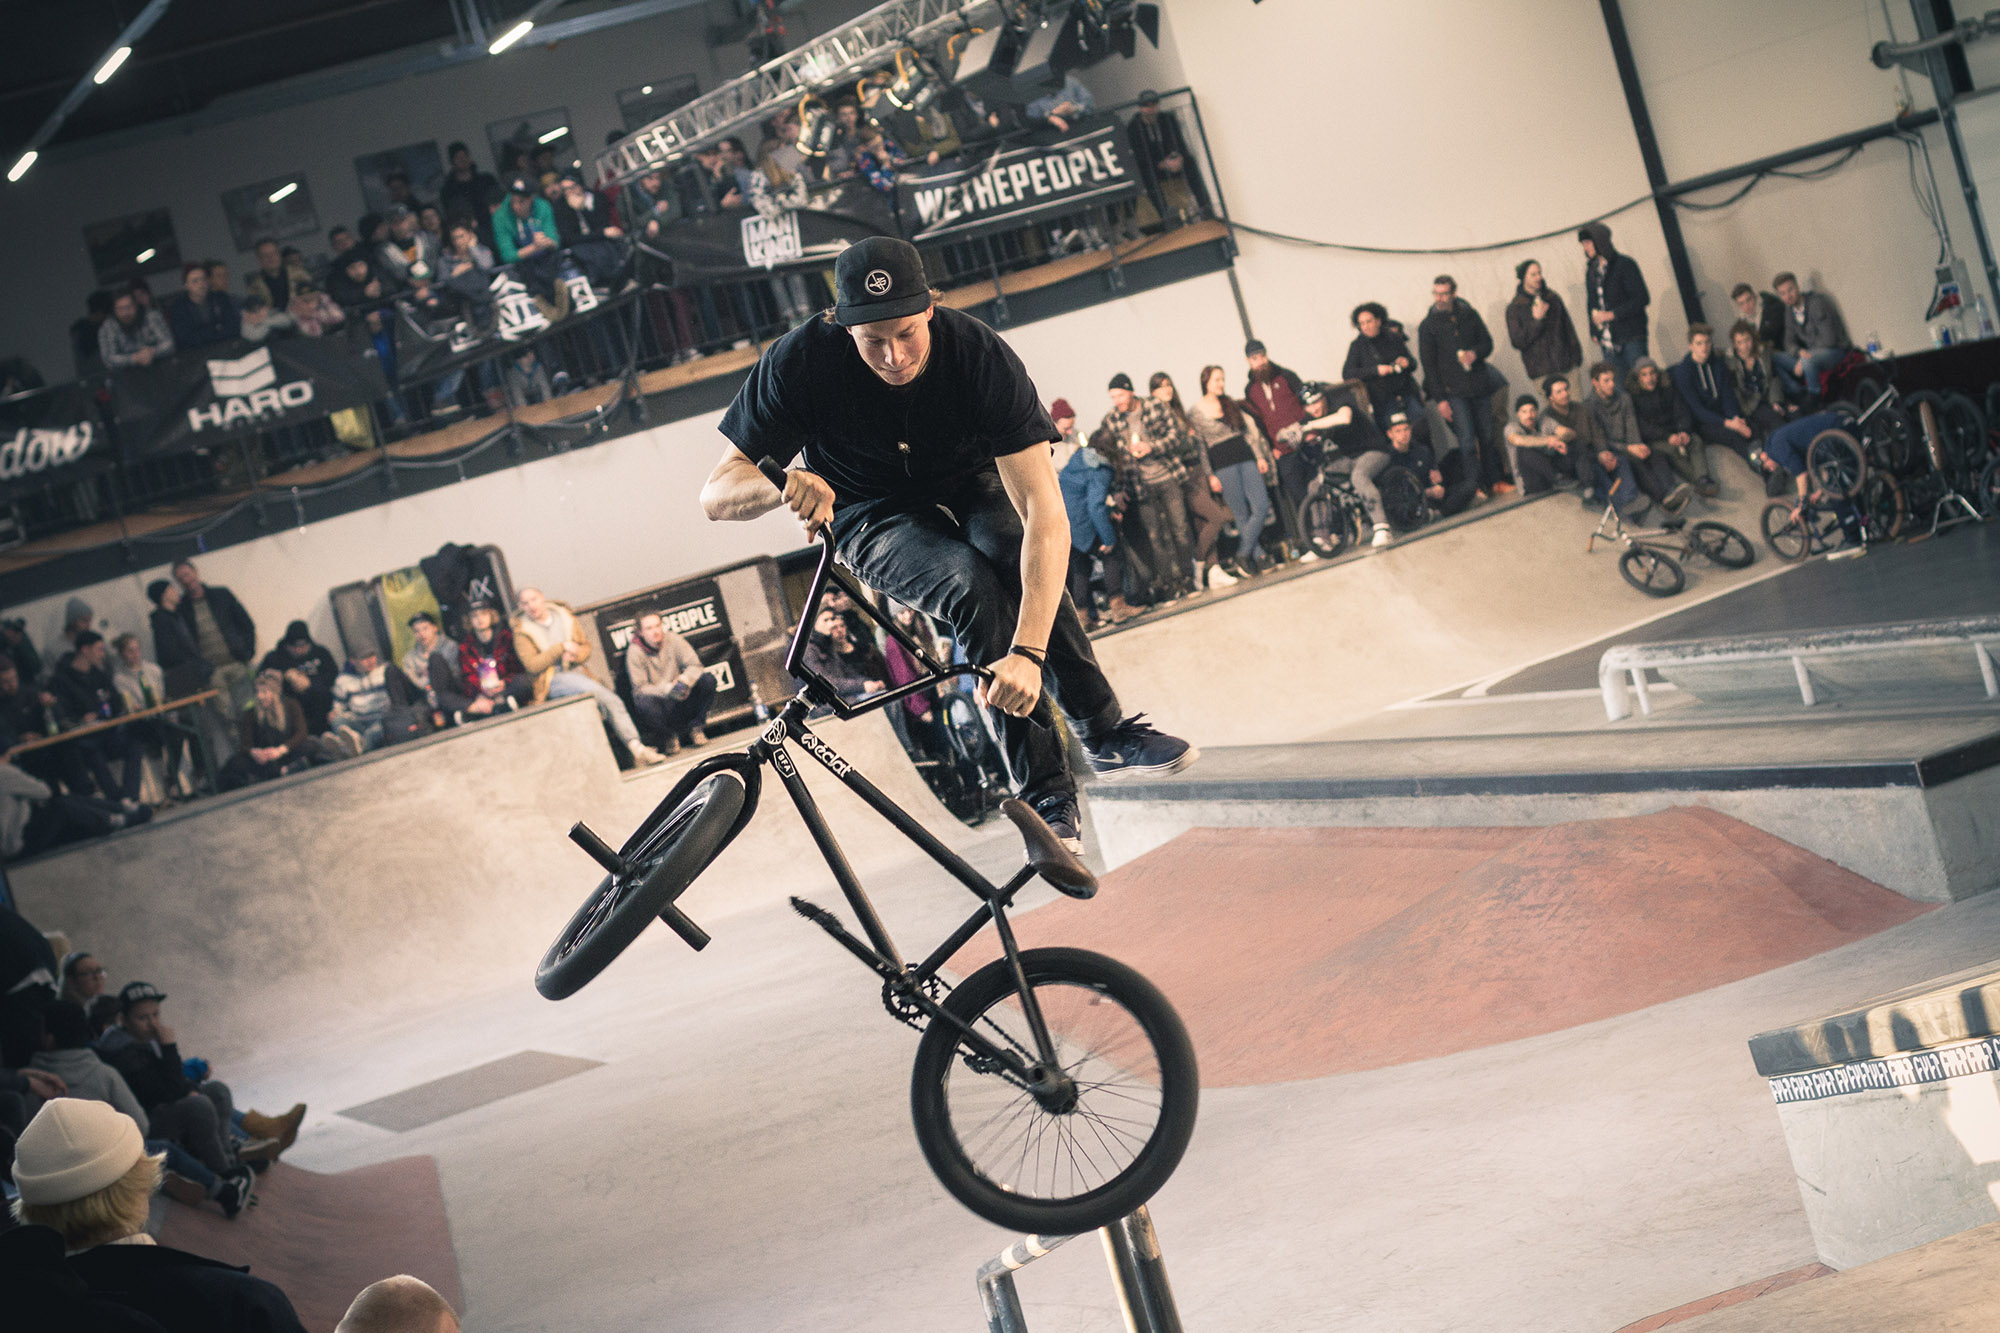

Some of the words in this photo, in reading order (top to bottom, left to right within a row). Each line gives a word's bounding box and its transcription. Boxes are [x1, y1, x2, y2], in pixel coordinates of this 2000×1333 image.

[914, 140, 1125, 224] WETHEPEOPLE
[187, 380, 314, 432] HARO
[609, 603, 718, 650] WEPEOPLE
